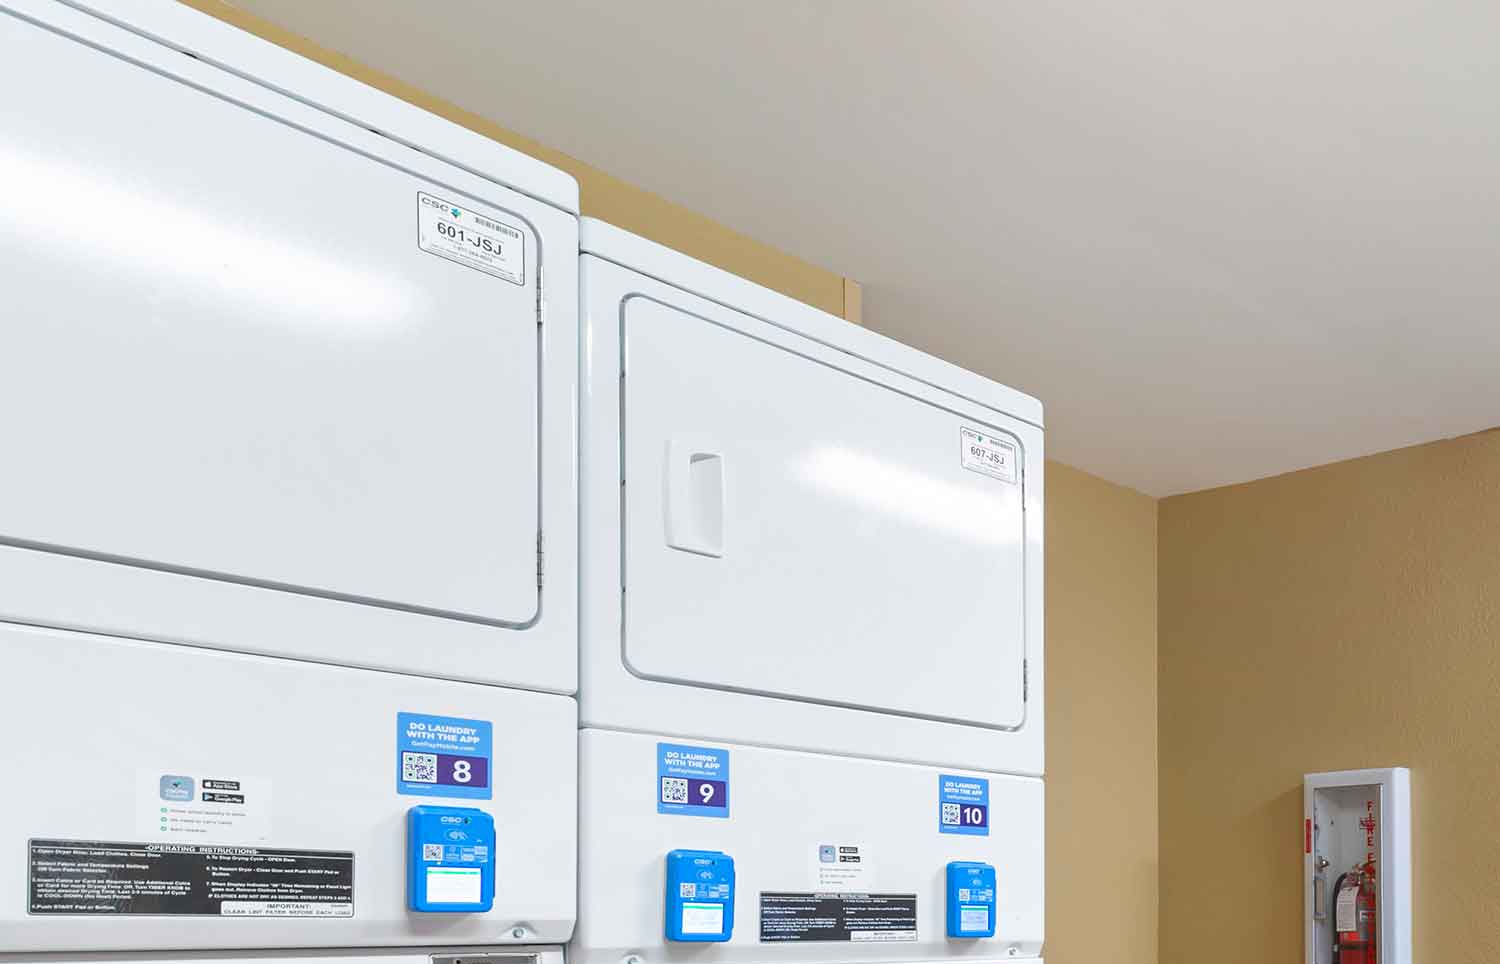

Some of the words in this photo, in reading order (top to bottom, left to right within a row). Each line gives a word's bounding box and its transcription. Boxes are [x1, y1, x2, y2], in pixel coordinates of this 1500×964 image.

[422, 197, 449, 212] CSC
[437, 222, 502, 255] 601-JSJ
[971, 446, 1004, 464] 607-JSJ
[407, 730, 435, 740] WITH
[437, 733, 458, 742] THE
[409, 722, 425, 730] DO
[428, 724, 476, 735] LAUNDRY
[453, 760, 471, 783] 8
[700, 783, 714, 803] 9
[964, 808, 982, 824] 10
